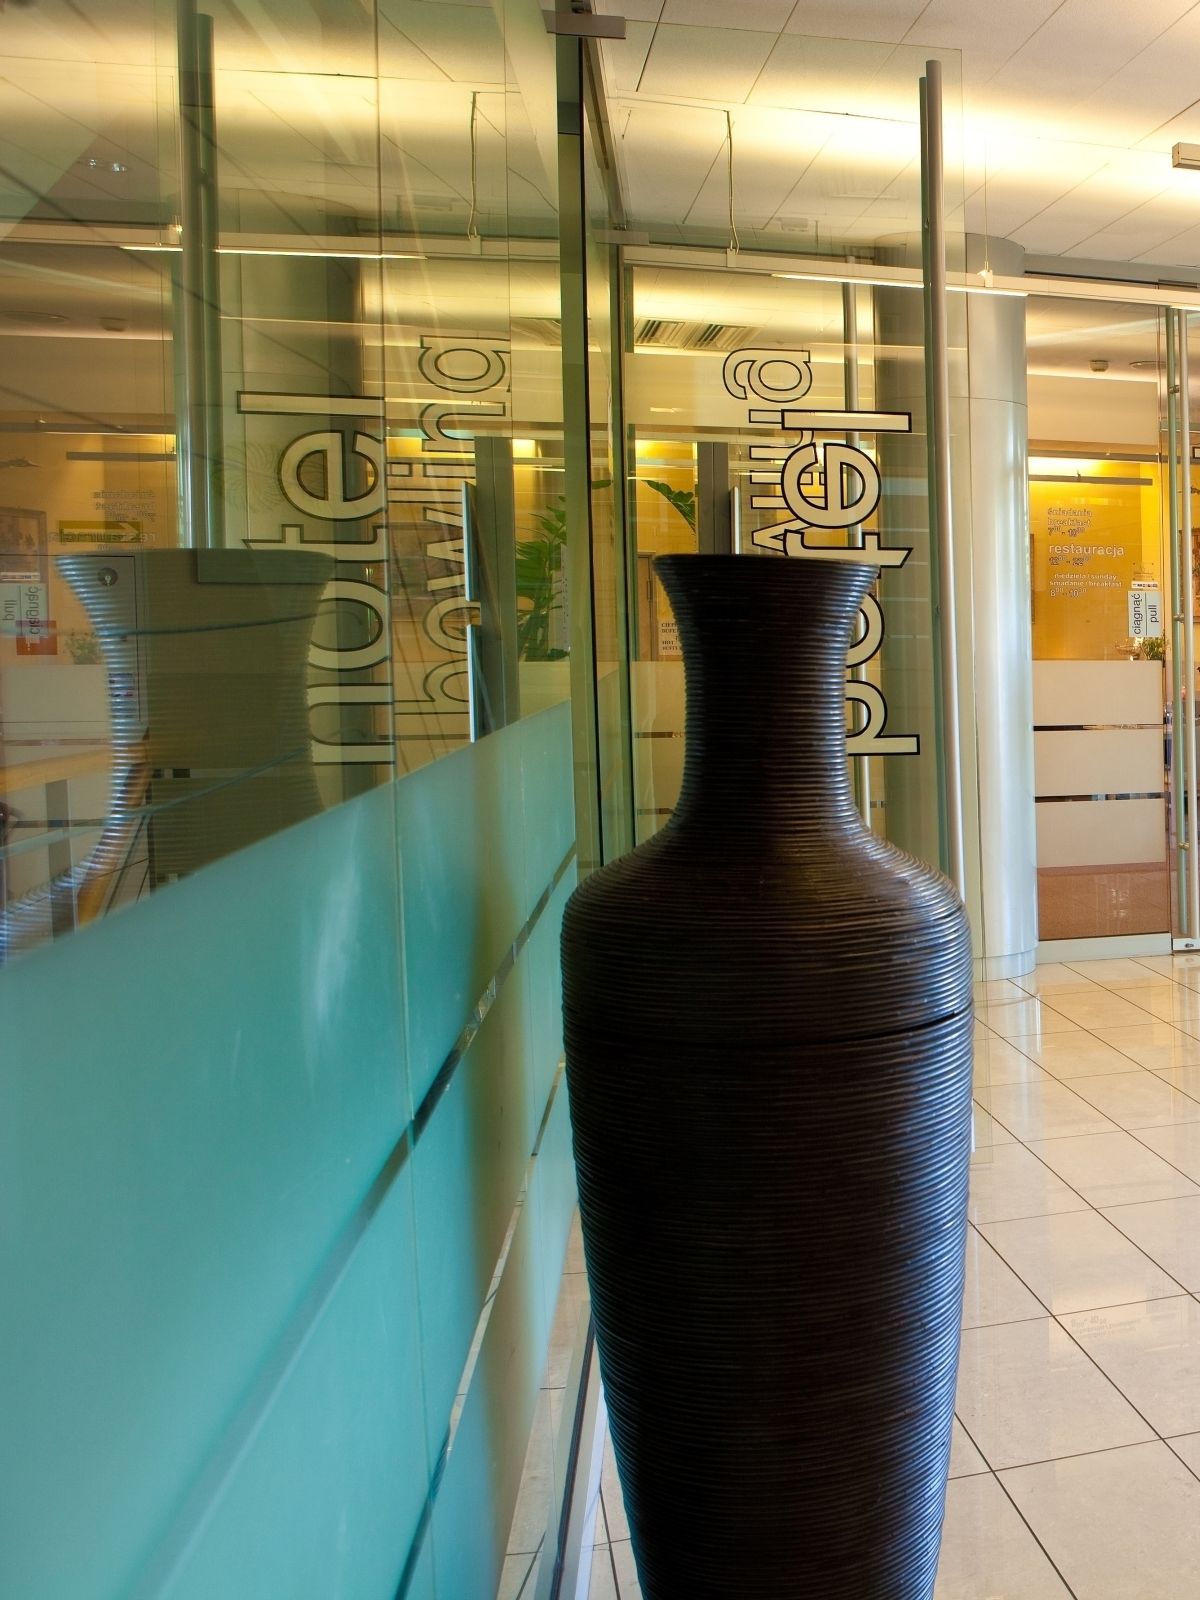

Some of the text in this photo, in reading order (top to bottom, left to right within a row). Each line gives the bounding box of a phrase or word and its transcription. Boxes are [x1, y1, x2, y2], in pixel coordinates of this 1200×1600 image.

[1049, 543, 1124, 558] restauracja
[1131, 593, 1143, 635] ciągnąć
[1148, 604, 1159, 623] pull
